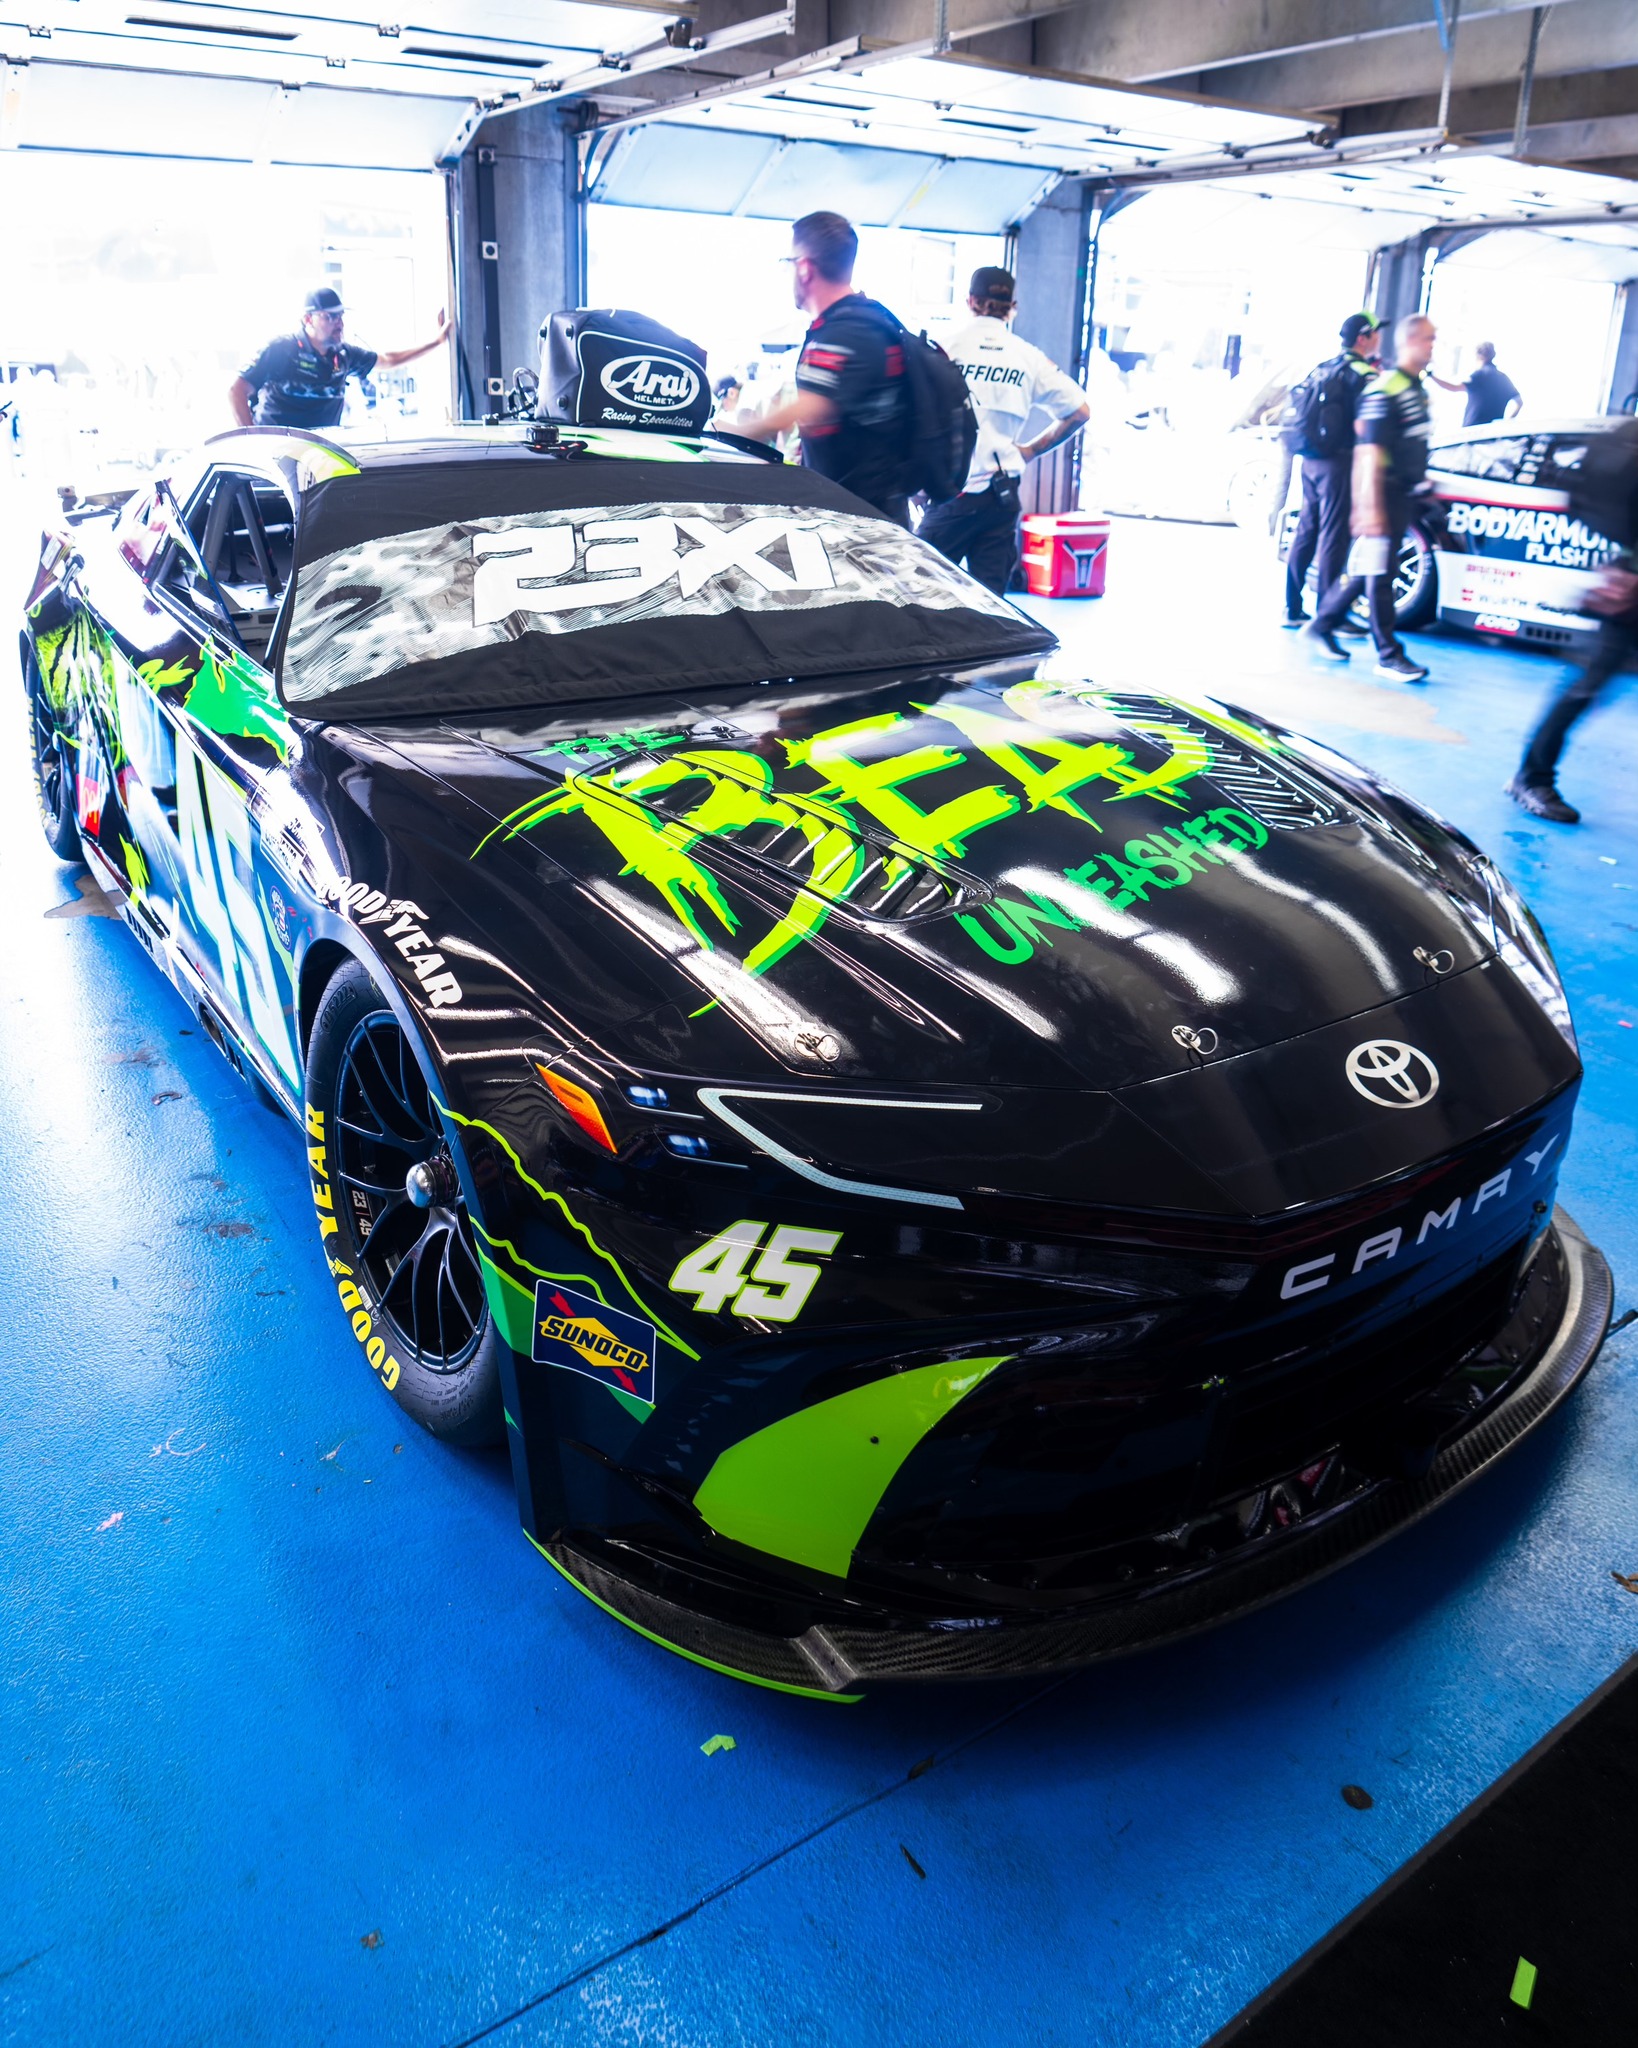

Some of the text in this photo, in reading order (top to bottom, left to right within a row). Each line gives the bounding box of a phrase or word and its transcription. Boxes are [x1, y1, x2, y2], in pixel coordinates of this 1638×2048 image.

[607, 360, 691, 398] Arai
[601, 407, 637, 424] Racing
[472, 515, 837, 628] 23XI
[1525, 541, 1589, 568] FLASH
[953, 807, 1268, 965] UNEASHED
[351, 1190, 368, 1209] 23
[1280, 1133, 1560, 1300] CAMRY
[669, 1219, 844, 1323] 45
[543, 1318, 646, 1372] SUNOCO
